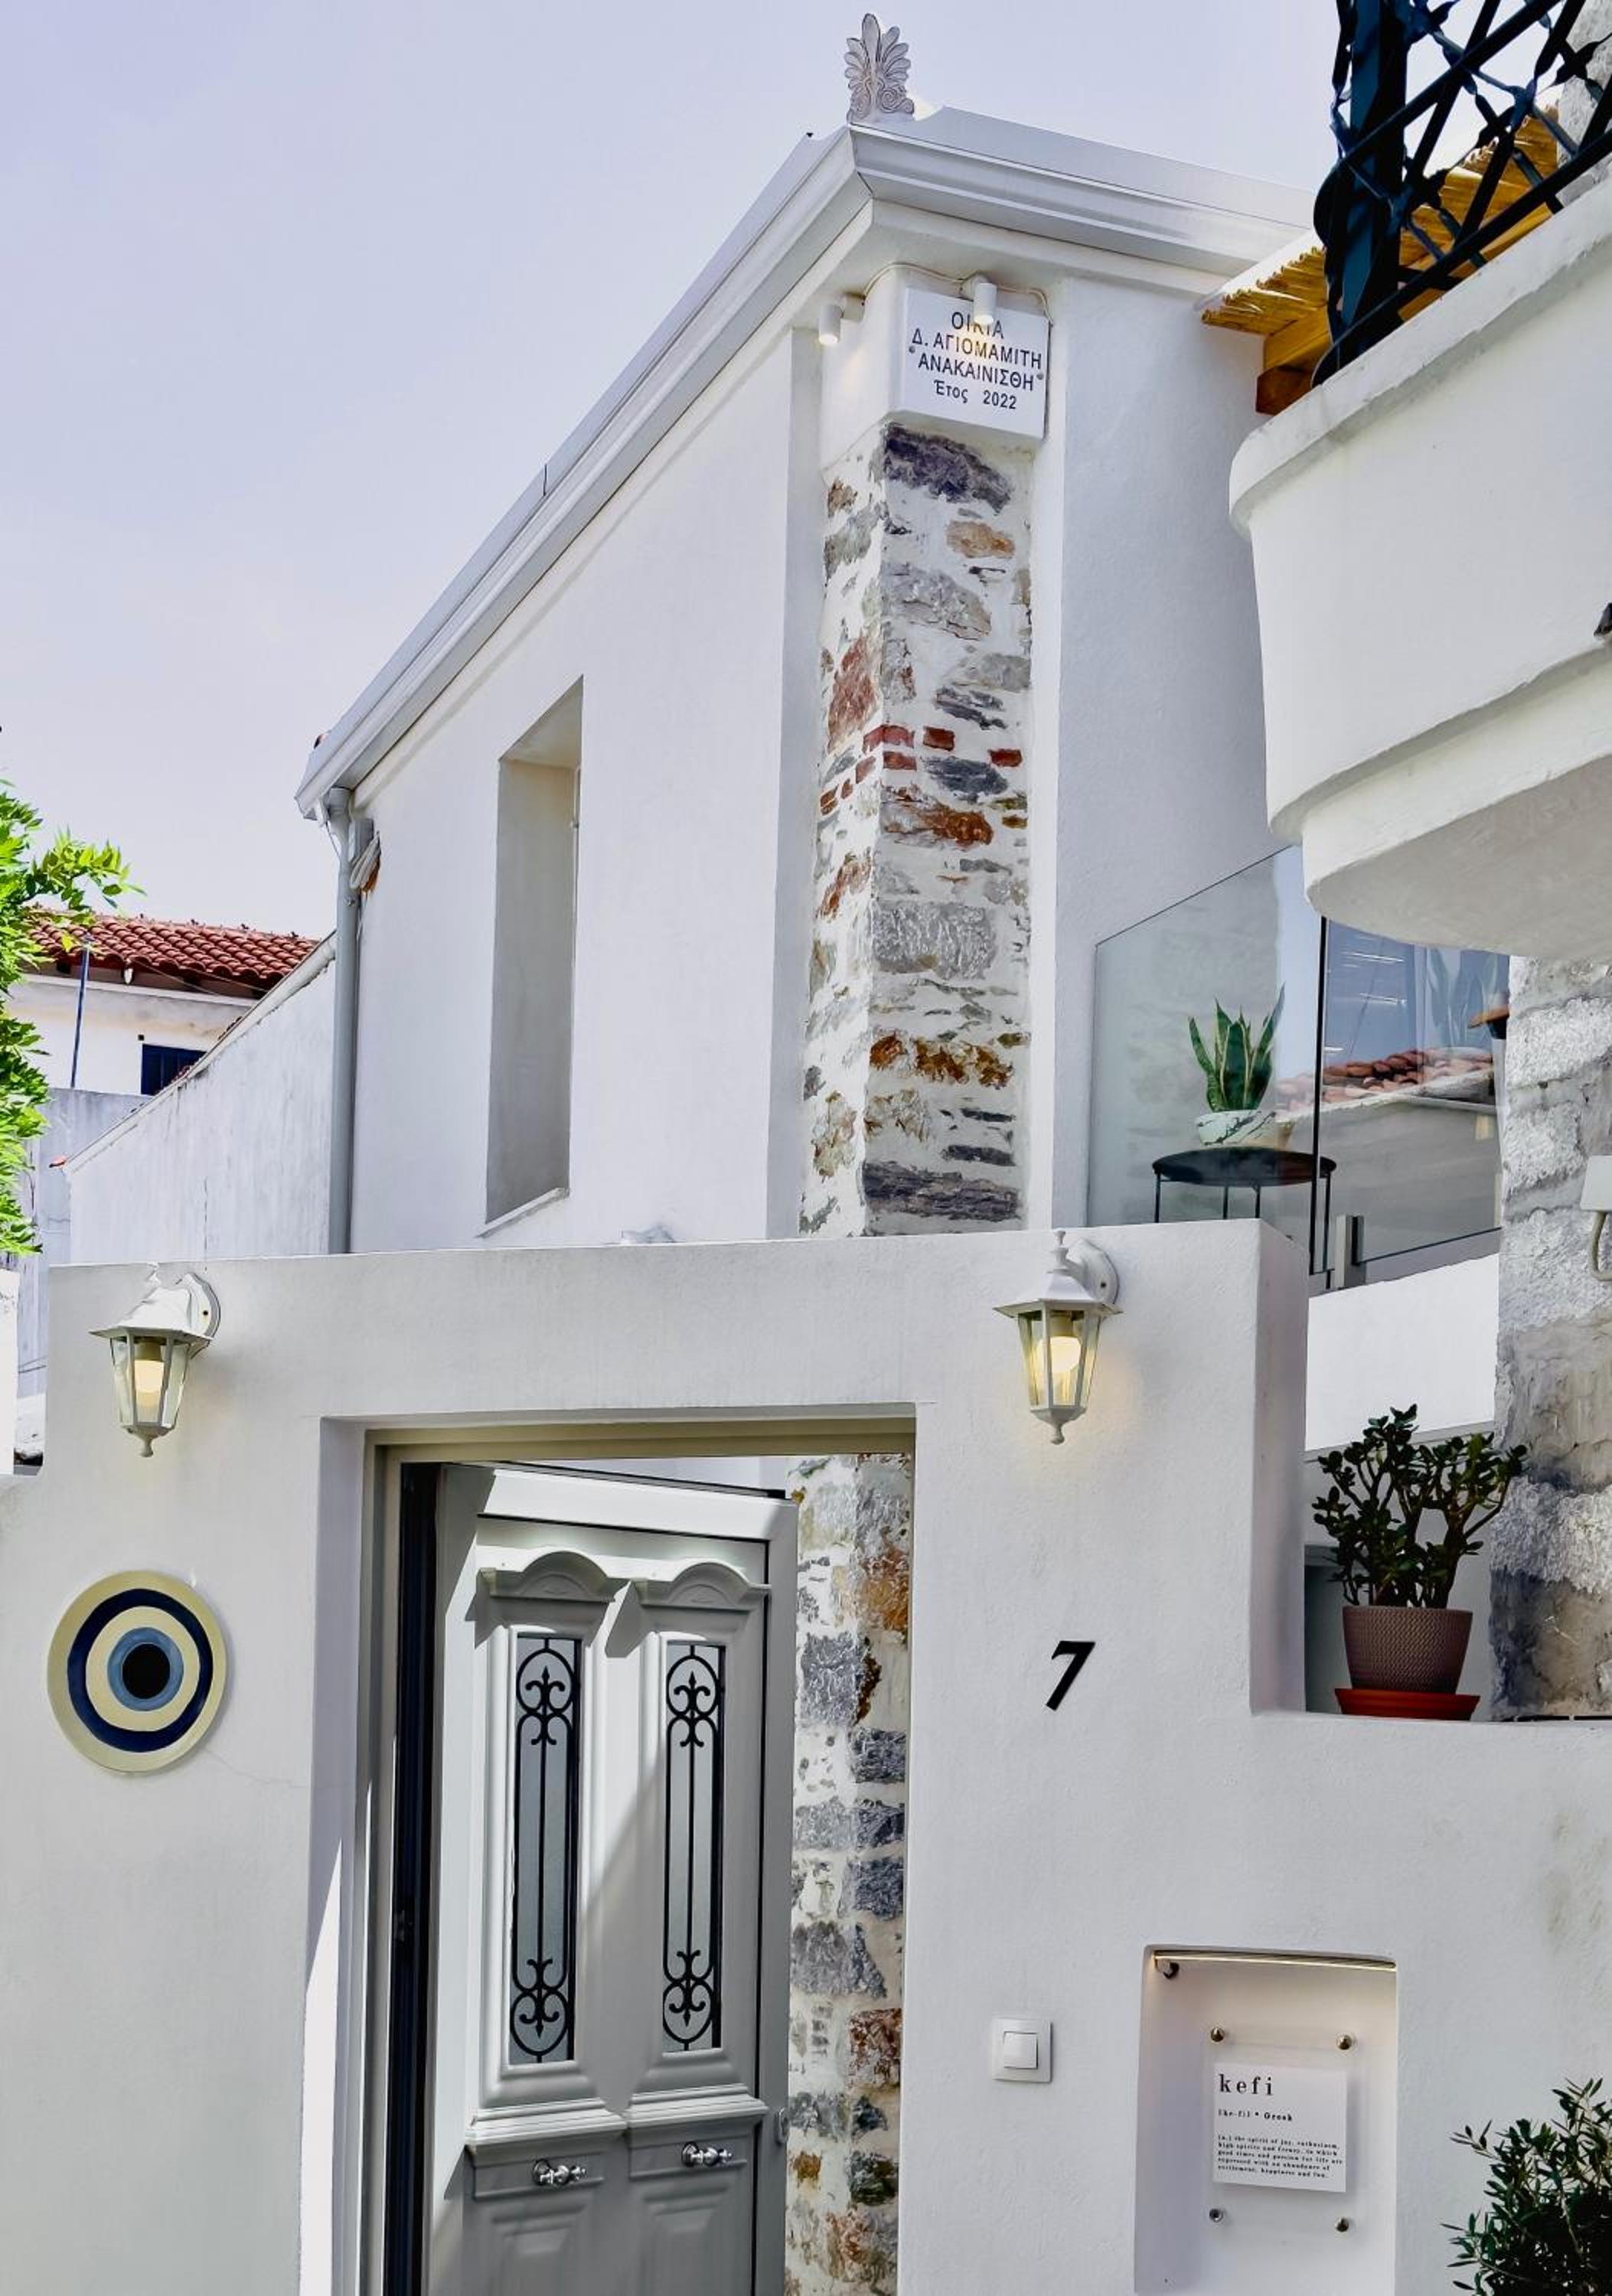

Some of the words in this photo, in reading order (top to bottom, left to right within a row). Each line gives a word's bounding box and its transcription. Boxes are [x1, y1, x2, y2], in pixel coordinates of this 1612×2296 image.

[912, 328, 928, 346] Δ.
[933, 332, 1042, 370] ΑΓΙΟΜΑΜΙΤΗ
[918, 353, 1034, 392] ΑΝΑΚΑΙΝΙΣΘΗ
[934, 379, 968, 404] Έτος
[983, 390, 1017, 409] 2022
[1046, 1640, 1096, 1711] 7
[1218, 2073, 1274, 2095] kefi
